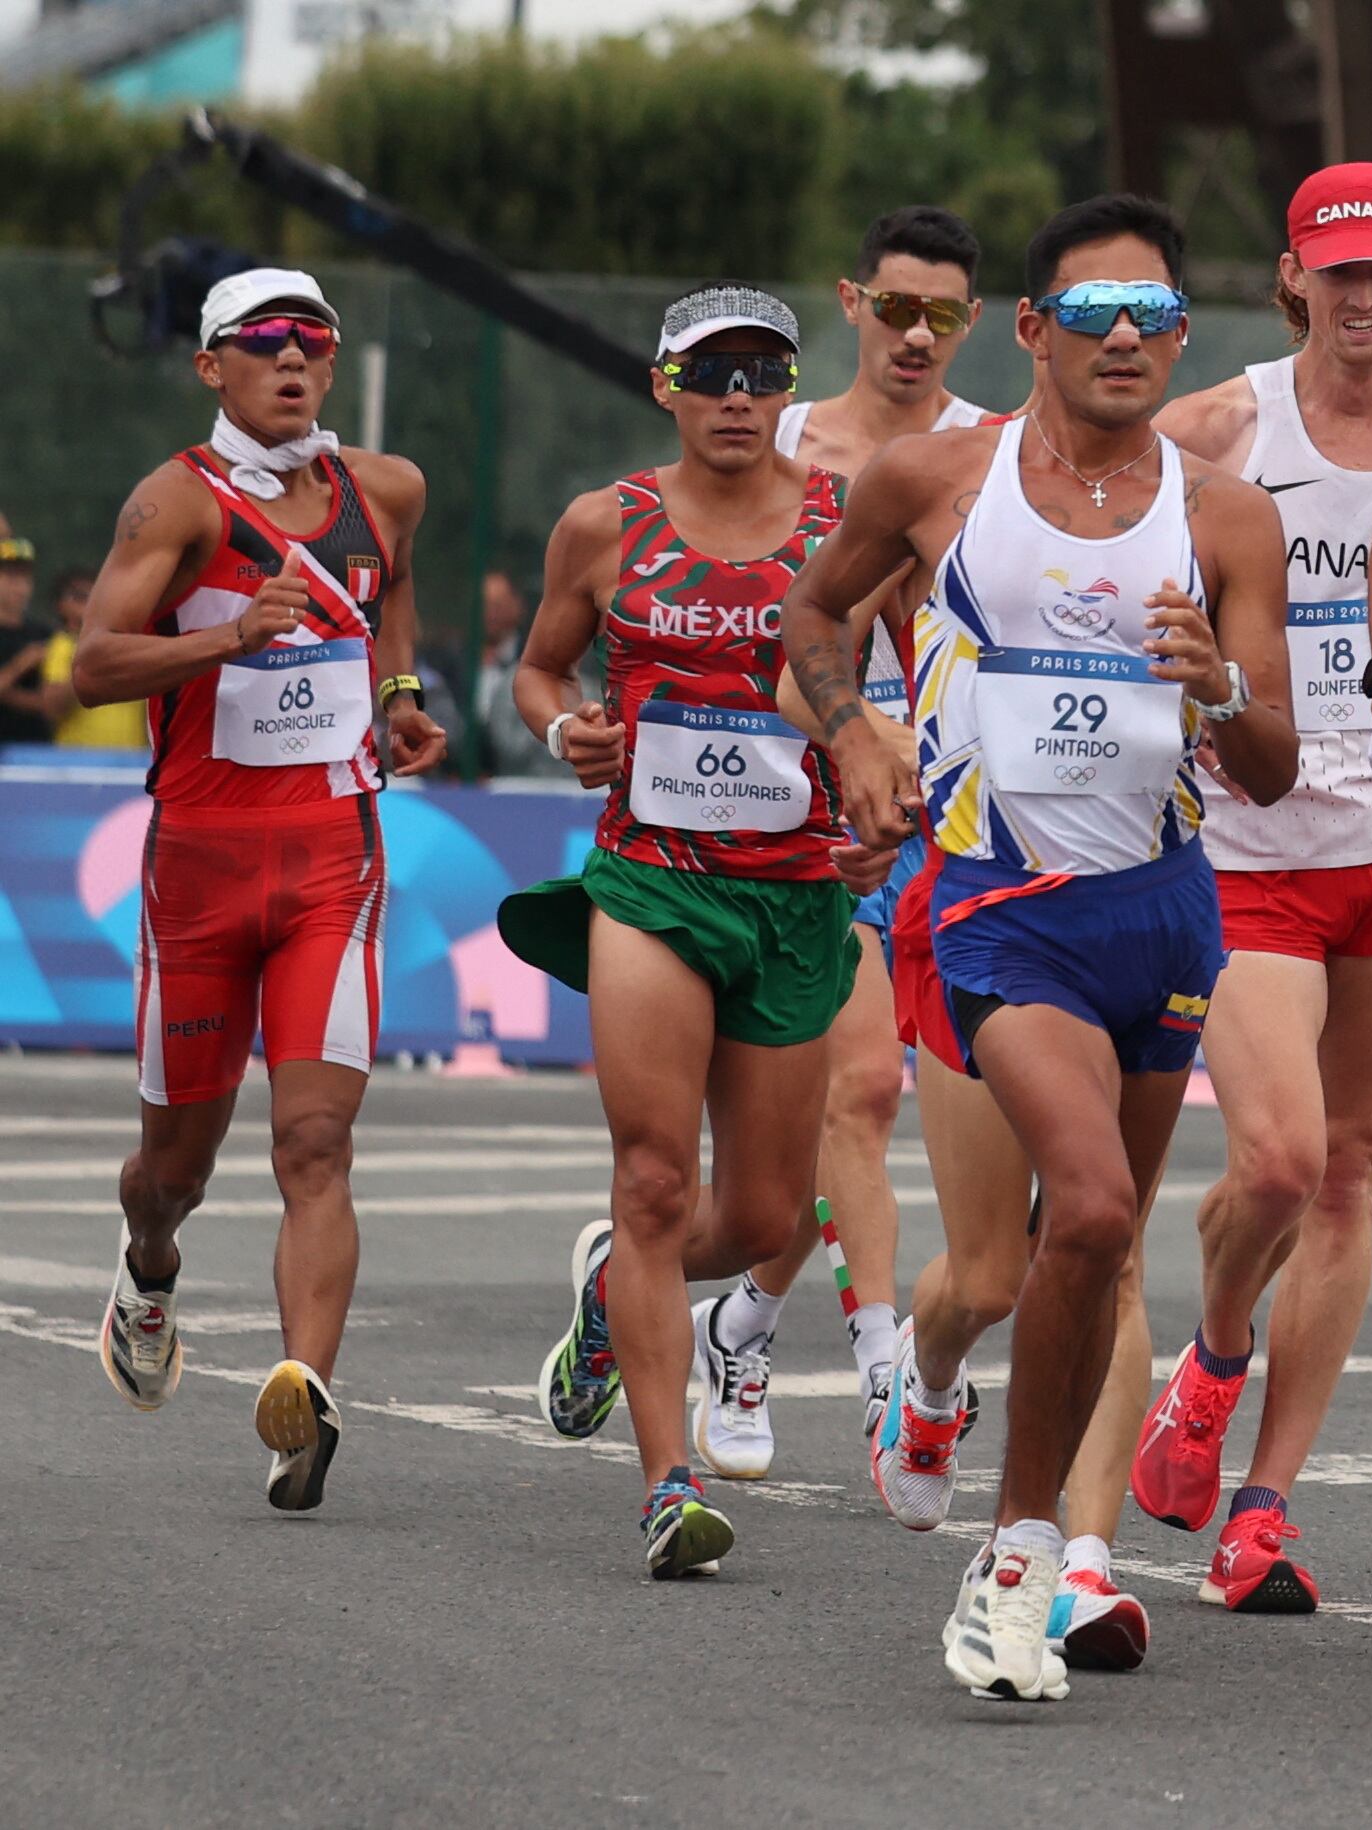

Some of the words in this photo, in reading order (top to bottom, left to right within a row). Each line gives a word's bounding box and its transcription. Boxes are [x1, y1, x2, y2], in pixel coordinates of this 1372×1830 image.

[1296, 607, 1335, 620] PARIS
[268, 653, 300, 665] PARIS
[303, 648, 331, 661] 2024
[1030, 655, 1082, 671] PARIS
[1088, 658, 1130, 674] 2024
[1319, 637, 1356, 674] 18
[278, 677, 314, 712] 68
[253, 713, 336, 734] RODRIGUEZ
[683, 710, 723, 726] PARIS
[729, 715, 768, 729] 2024
[1050, 692, 1108, 734] 29
[1034, 737, 1120, 759] PINTADO
[695, 743, 747, 778] 66
[651, 776, 706, 798] PALMA
[710, 782, 792, 802] OLIVARES
